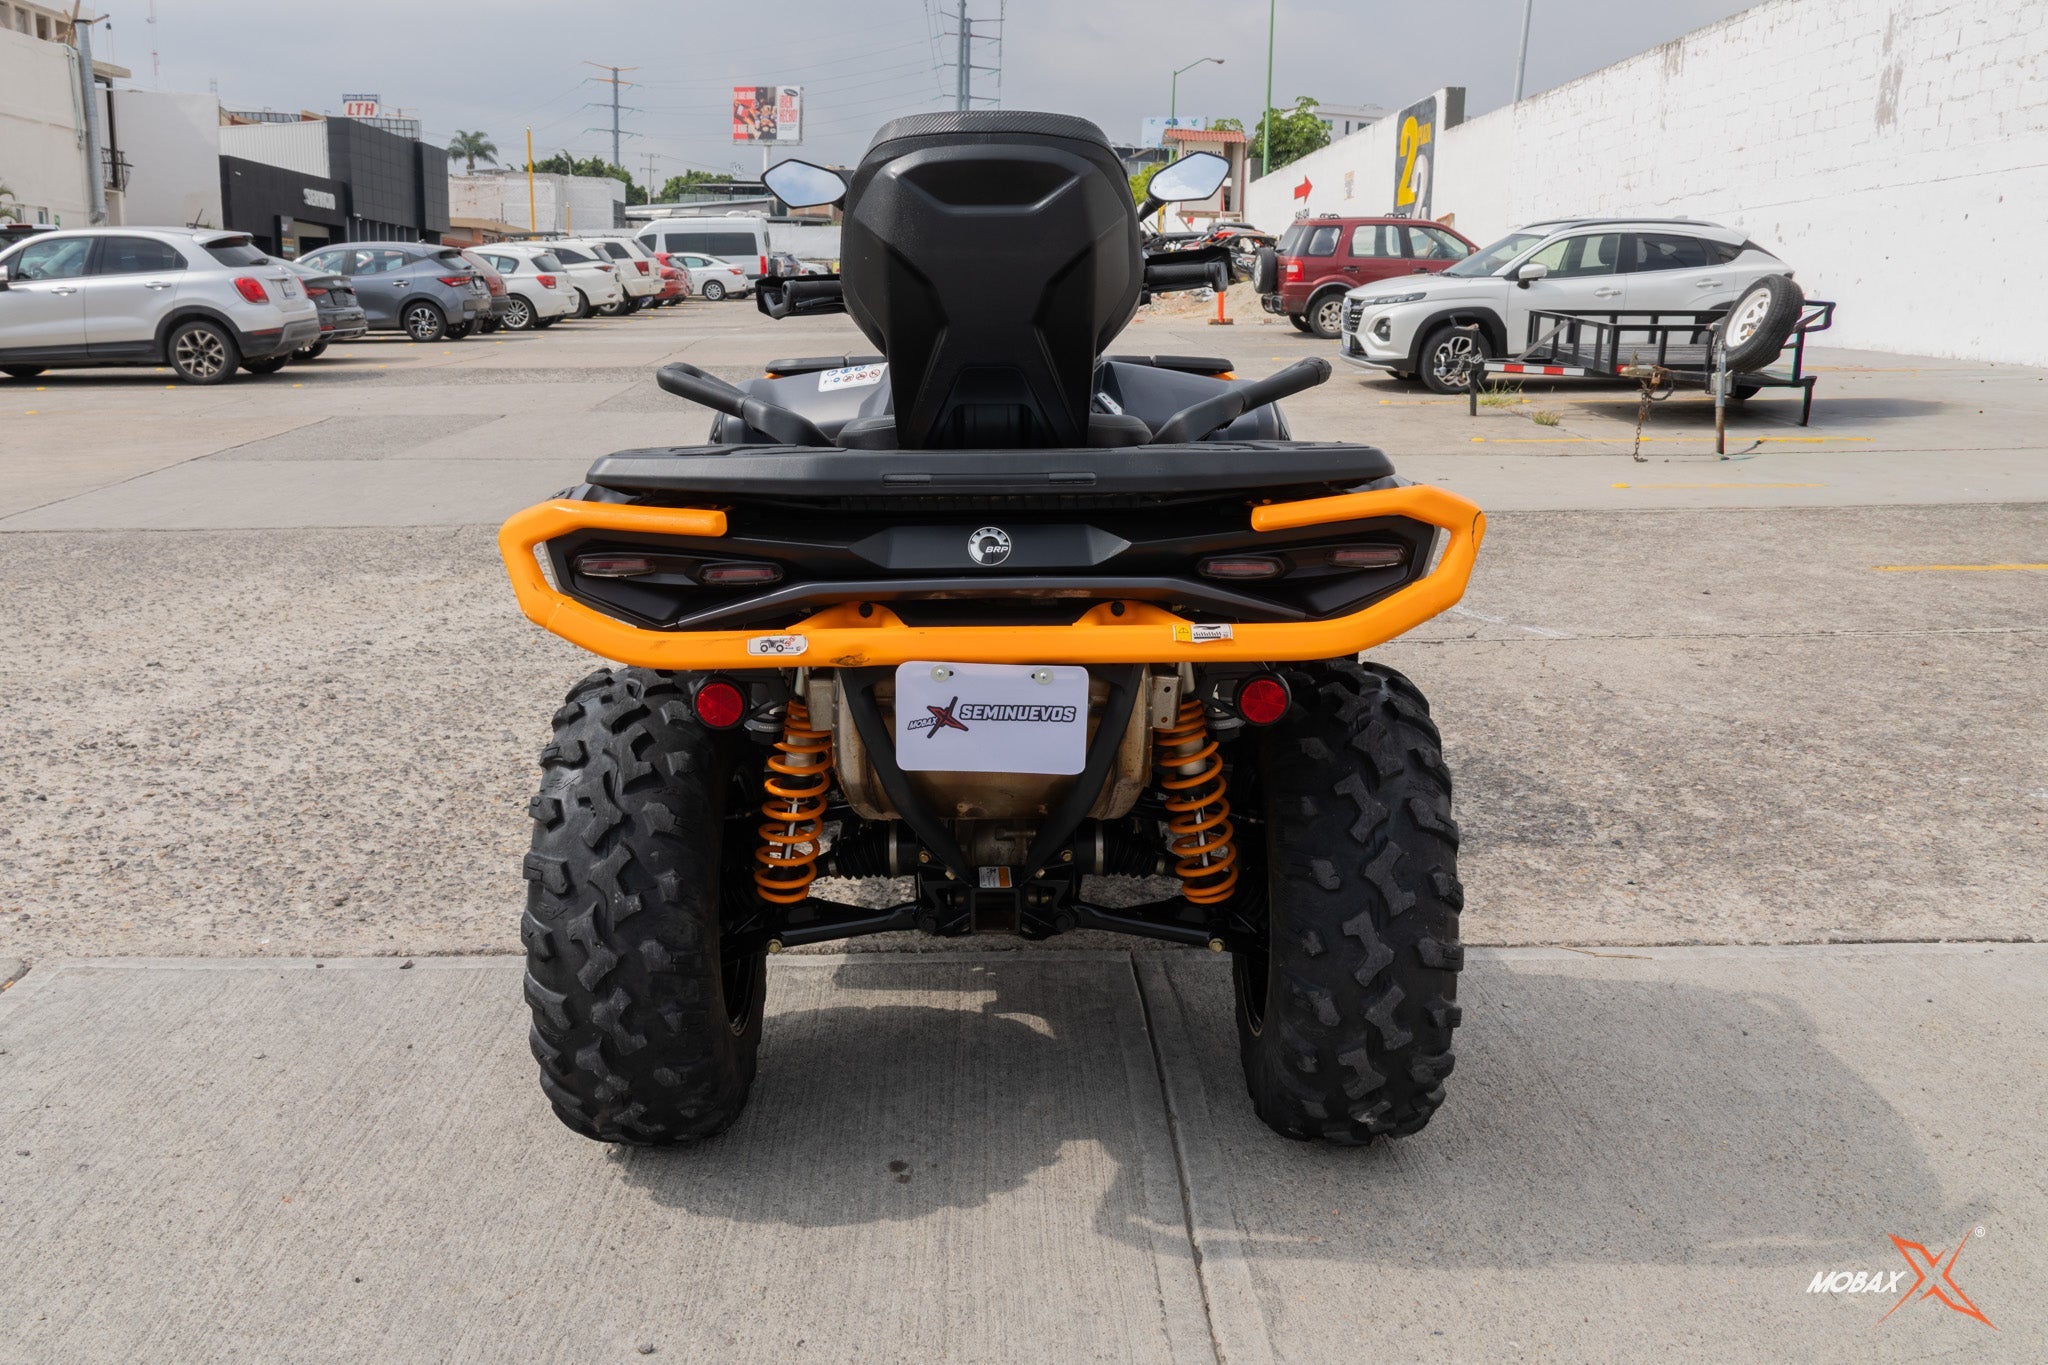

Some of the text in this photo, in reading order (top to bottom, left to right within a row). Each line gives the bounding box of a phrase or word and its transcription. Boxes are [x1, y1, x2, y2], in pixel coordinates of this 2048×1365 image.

[347, 103, 375, 116] LTH
[985, 545, 1009, 553] BRP
[908, 716, 939, 731] MOBAX
[959, 703, 1077, 723] SEMINUEVOS
